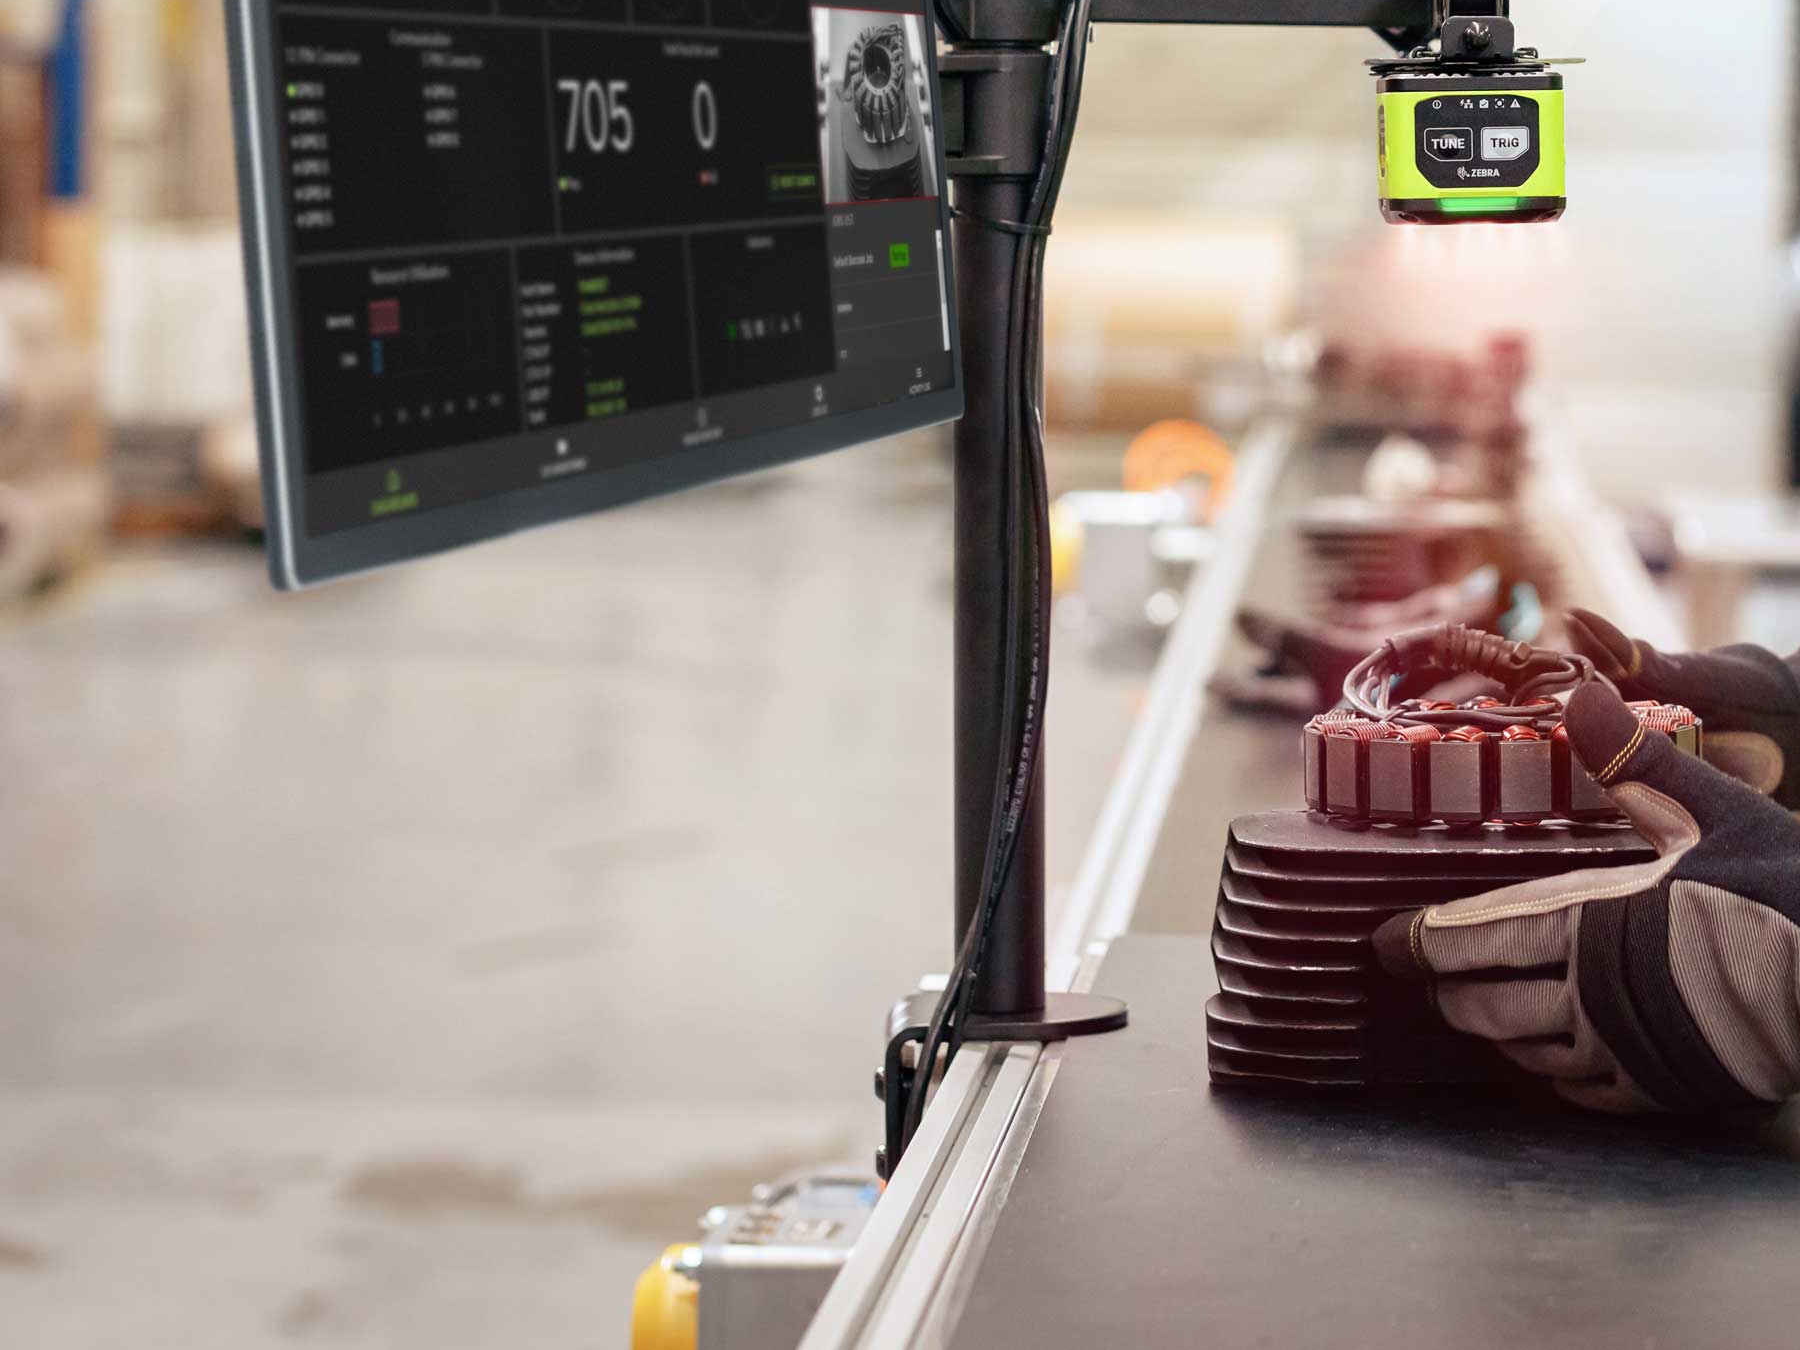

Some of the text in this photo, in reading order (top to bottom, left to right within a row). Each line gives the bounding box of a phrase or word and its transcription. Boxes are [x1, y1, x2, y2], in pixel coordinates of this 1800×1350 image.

[557, 79, 634, 154] 705
[692, 81, 718, 151] 0
[1431, 138, 1466, 150] TUNE
[1490, 137, 1520, 149] TRIG
[1470, 168, 1500, 178] ZEBRA
